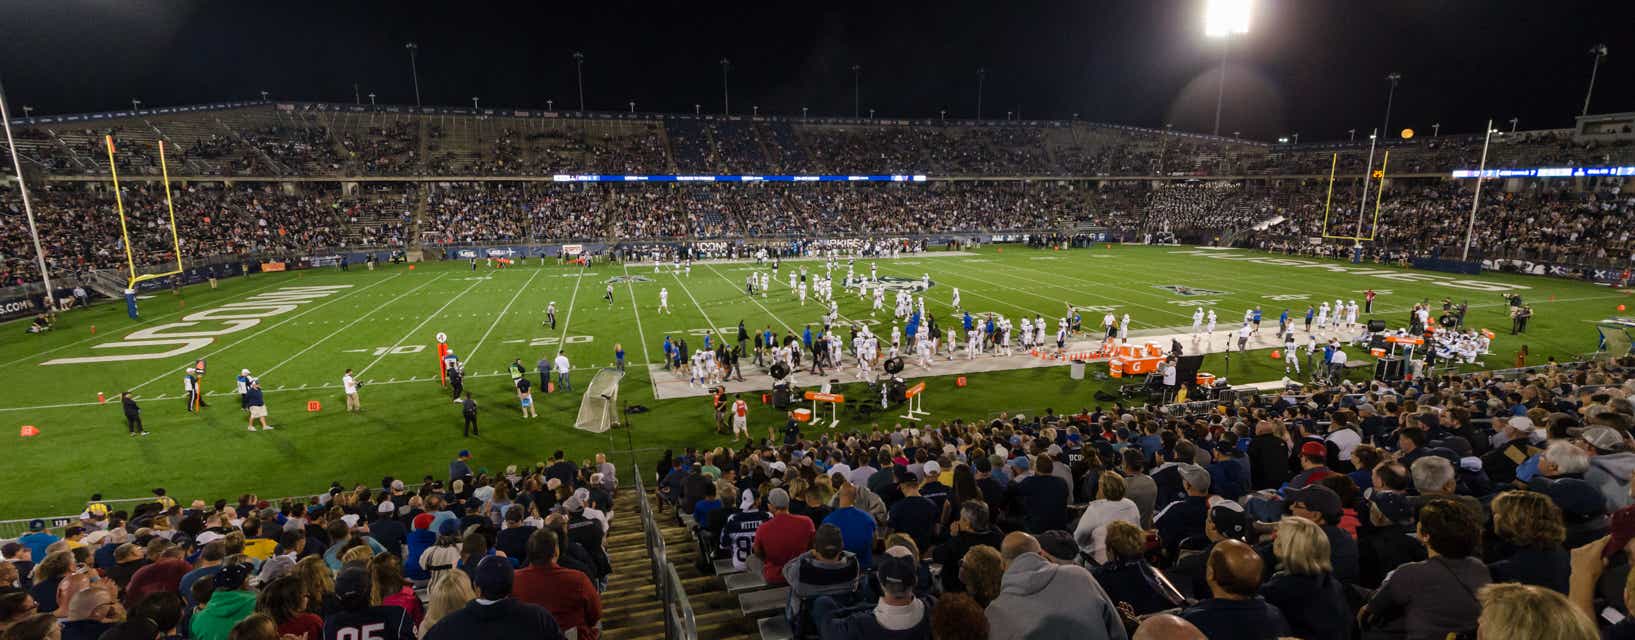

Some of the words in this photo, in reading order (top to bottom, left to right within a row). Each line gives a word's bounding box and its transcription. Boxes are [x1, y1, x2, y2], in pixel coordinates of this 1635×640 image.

[38, 284, 354, 366] UCONN
[529, 335, 594, 346] 20
[372, 344, 427, 356] 10
[1132, 361, 1141, 372] G
